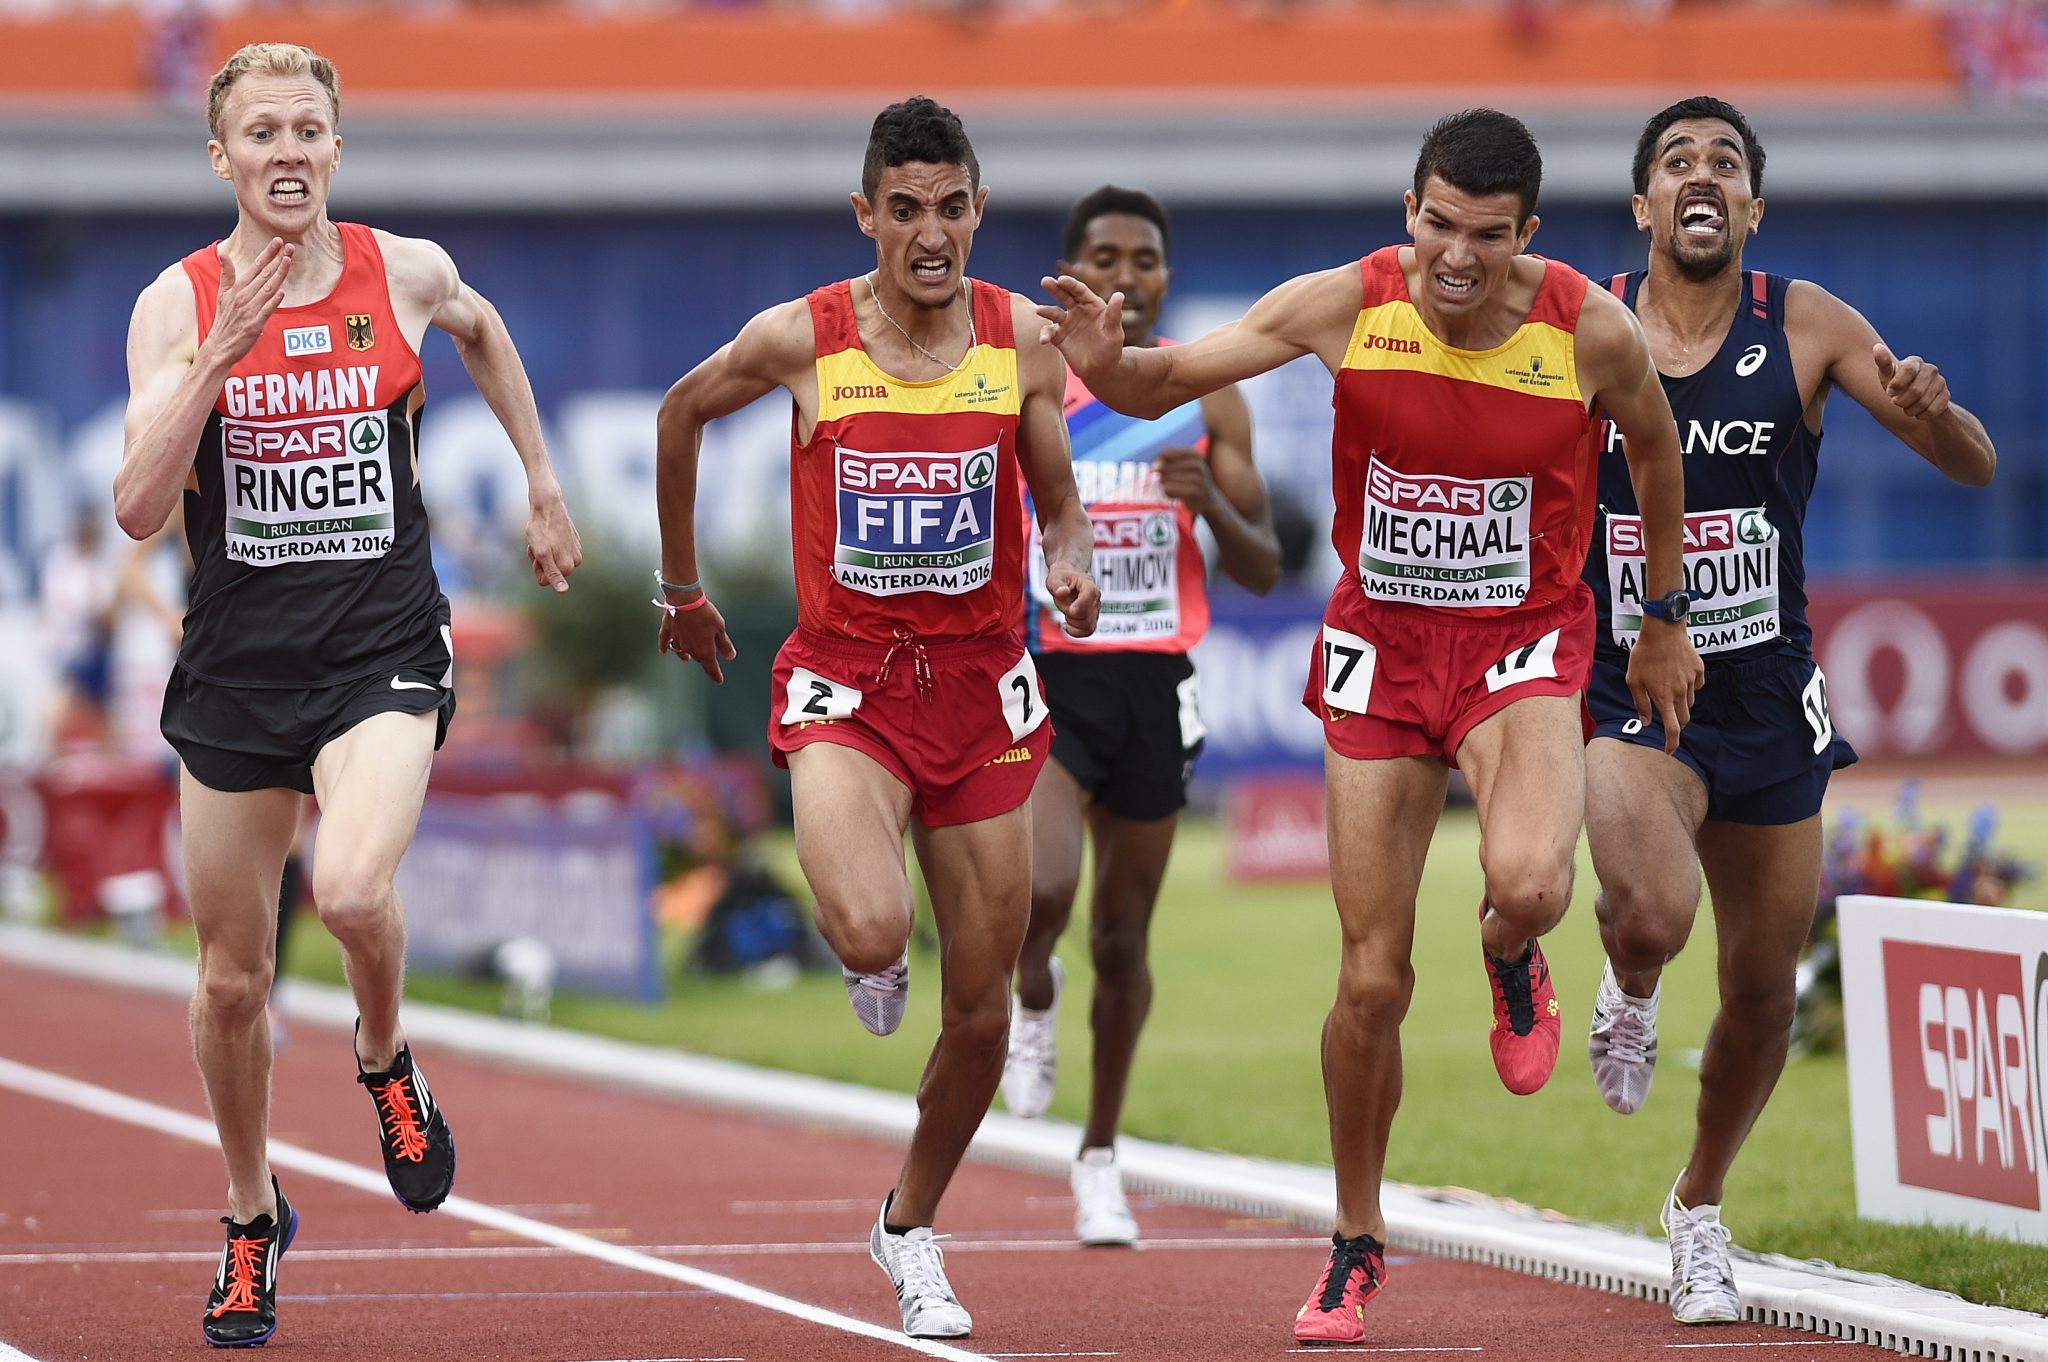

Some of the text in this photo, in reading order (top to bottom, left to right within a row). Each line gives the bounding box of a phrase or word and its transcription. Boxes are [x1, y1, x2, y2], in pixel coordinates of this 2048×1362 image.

[287, 331, 327, 350] DKB
[1364, 334, 1422, 354] Joma
[224, 366, 380, 418] GERMANY
[832, 384, 889, 401] Joma
[227, 425, 343, 458] SPAR
[234, 459, 386, 513] RINGER
[842, 459, 958, 489] SPAR
[1370, 468, 1481, 511] SPAR
[262, 519, 353, 537] I RUN CLEAN
[857, 496, 981, 545] FIFA
[1367, 504, 1523, 560] MECHAAL
[230, 535, 391, 561] AMSTERDAM 2016
[883, 555, 913, 567] RUN
[918, 552, 963, 568] CLEAN
[841, 562, 991, 590] AMSTERDAM 2016
[1361, 574, 1526, 601] AMSTERDAM 2016
[1403, 566, 1435, 579] RUN
[1439, 568, 1486, 582] CLEAN
[1696, 606, 1743, 624] CLEAN
[1742, 616, 1776, 640] 2016
[1324, 641, 1365, 693] 17
[802, 681, 833, 715] 2
[1919, 982, 2036, 1174] SPAR
